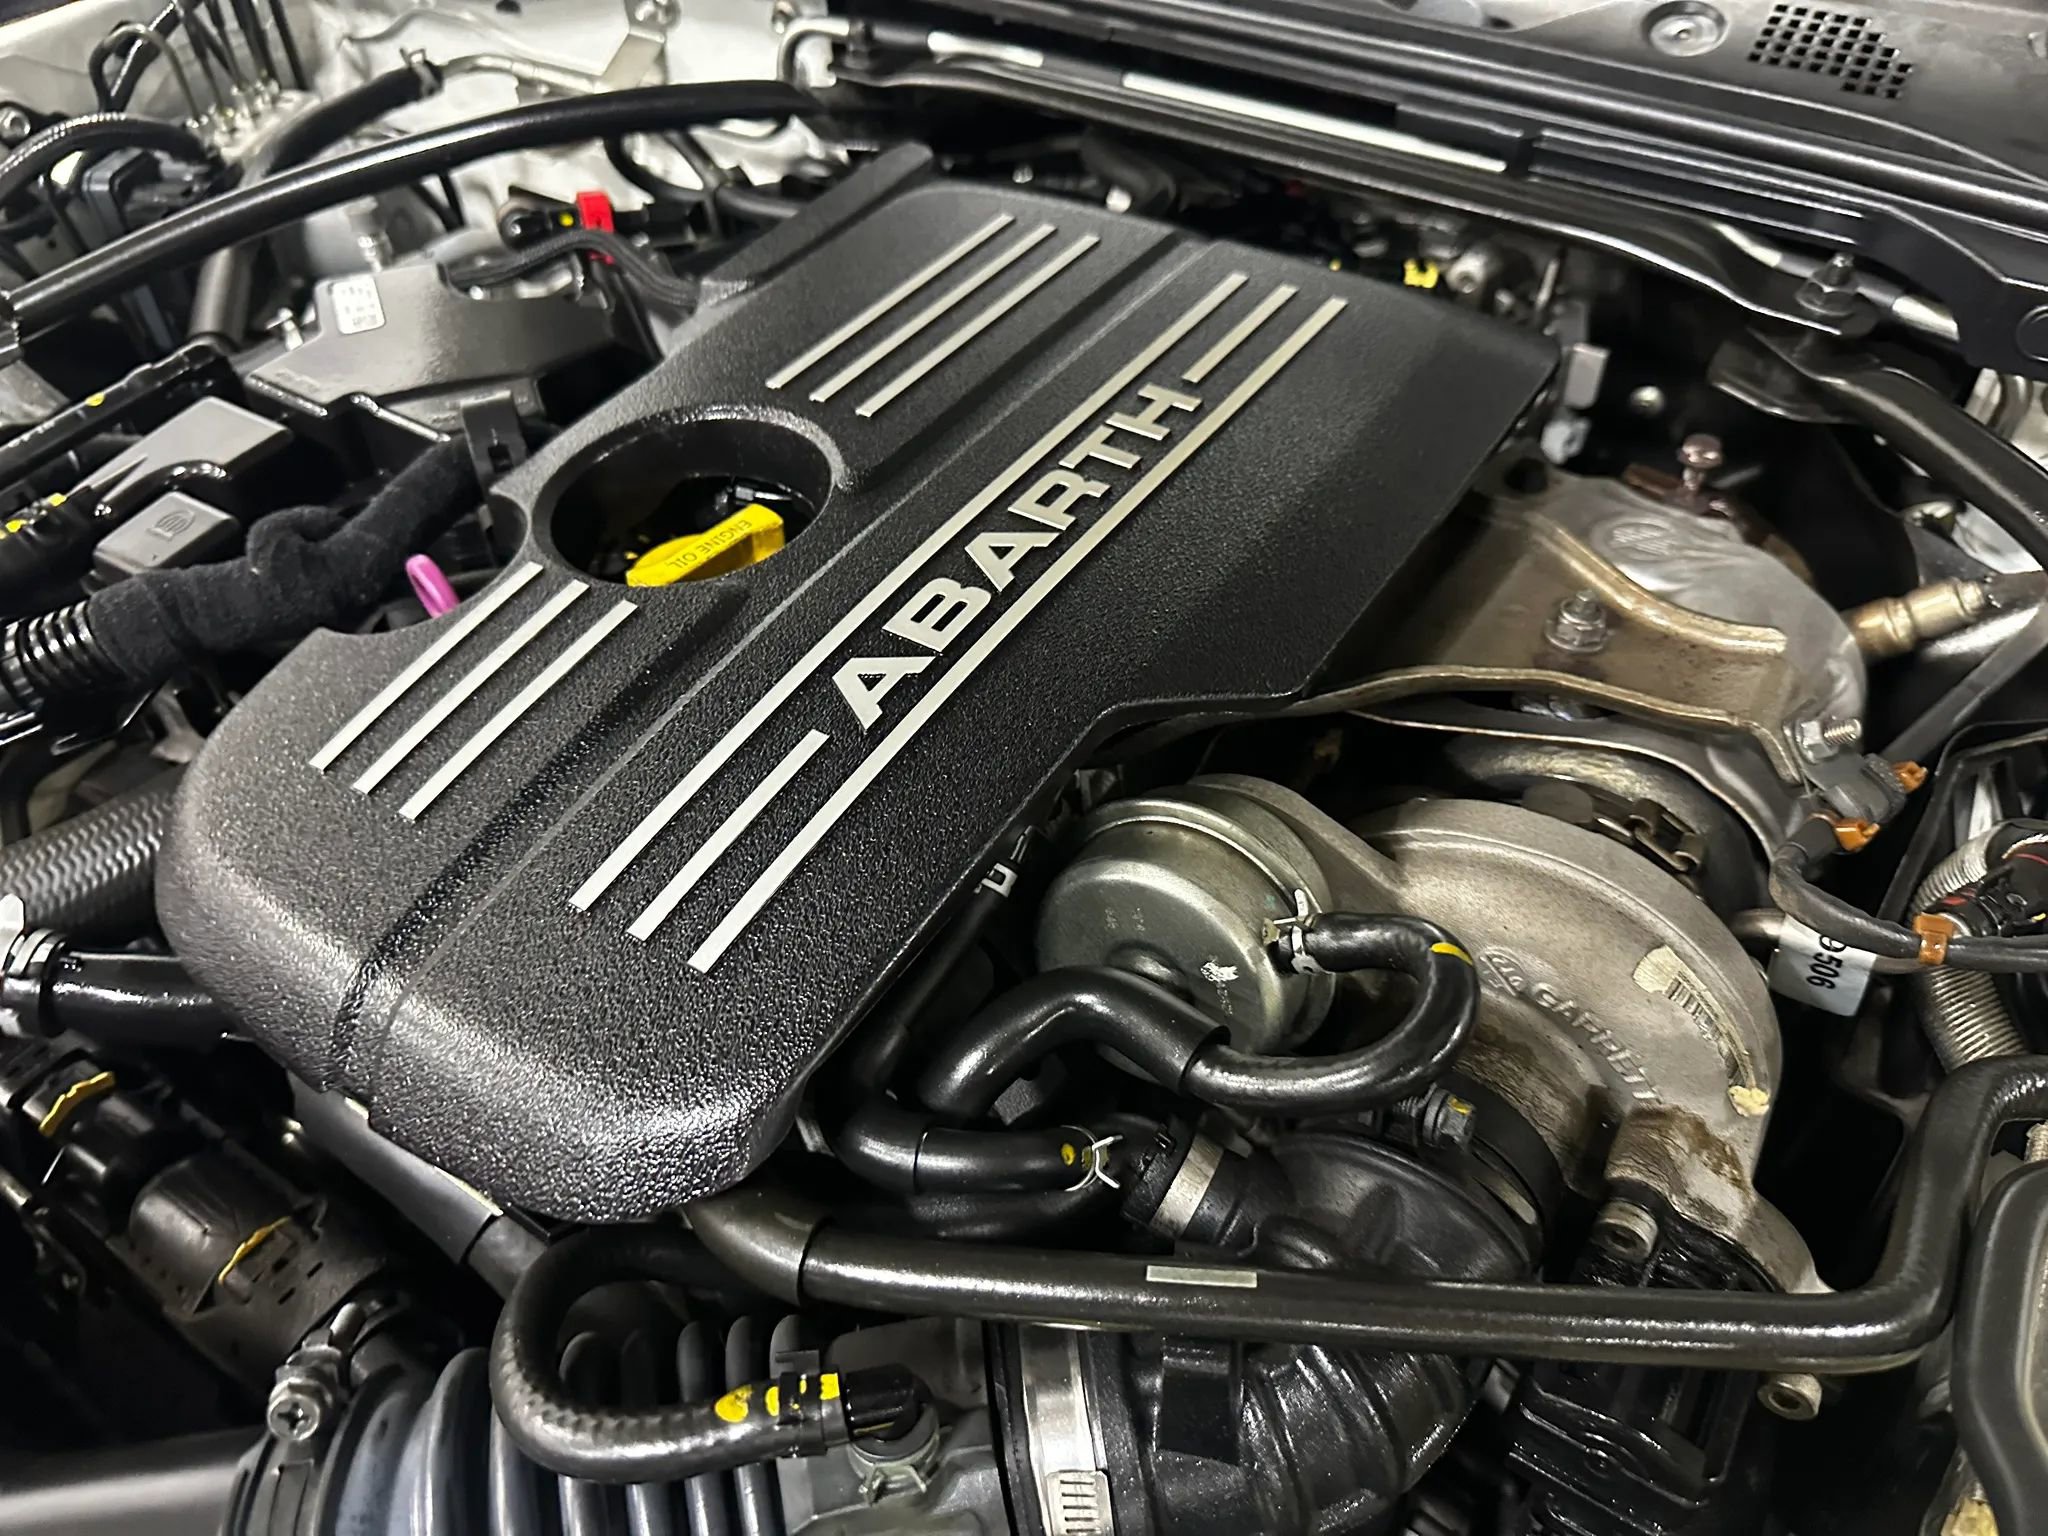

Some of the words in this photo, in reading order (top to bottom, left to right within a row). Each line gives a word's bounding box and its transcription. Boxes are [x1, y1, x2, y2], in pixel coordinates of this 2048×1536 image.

[667, 552, 698, 569] OIL
[700, 519, 753, 554] ENGINE
[832, 383, 1202, 731] ABARTH
[1532, 981, 1662, 1103] GARRETT
